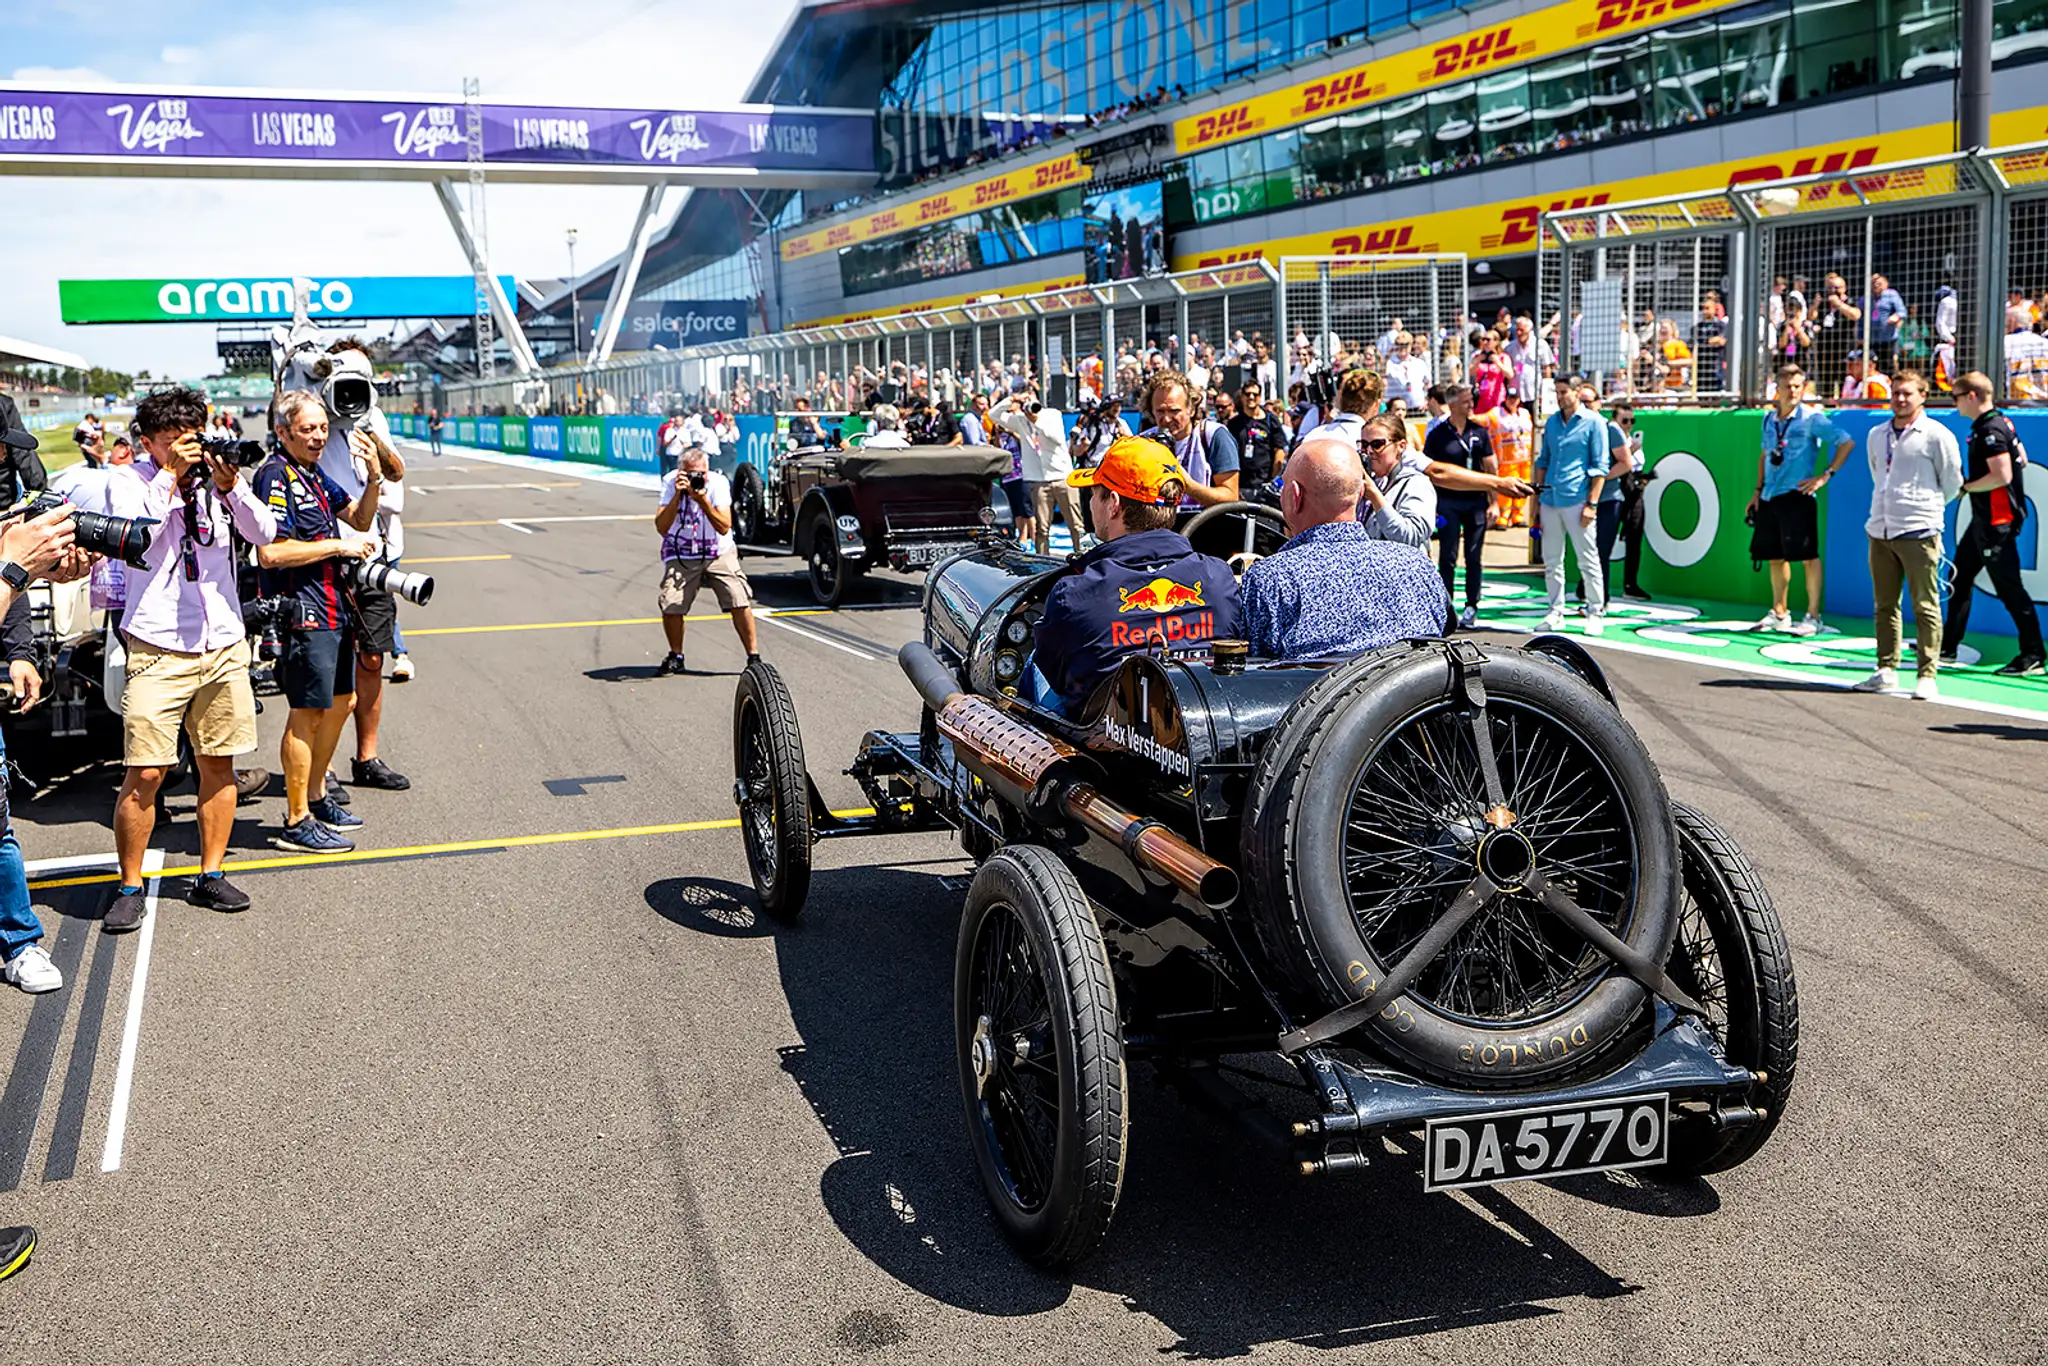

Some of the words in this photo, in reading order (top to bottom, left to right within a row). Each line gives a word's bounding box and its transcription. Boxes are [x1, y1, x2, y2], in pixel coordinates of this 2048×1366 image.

[1433, 28, 1518, 77] DHL
[1303, 72, 1371, 114] DHL
[106, 102, 204, 153] Vegas
[381, 109, 469, 158] Vegas
[630, 117, 710, 163] Vegas
[1197, 106, 1253, 143] DHL
[976, 179, 1010, 205] DHL
[1035, 158, 1076, 187] DHL
[612, 427, 654, 462] aramco
[839, 518, 857, 528] UK
[910, 550, 927, 562] BU
[1111, 616, 1163, 647] Red
[1166, 612, 1214, 641] Bull
[1140, 676, 1148, 723] 1
[1103, 714, 1127, 746] Max
[1127, 725, 1189, 777] Verstappen
[1459, 1023, 1591, 1068] DUNLOP
[1434, 1120, 1507, 1183] DA
[1514, 1105, 1661, 1171] 5770
